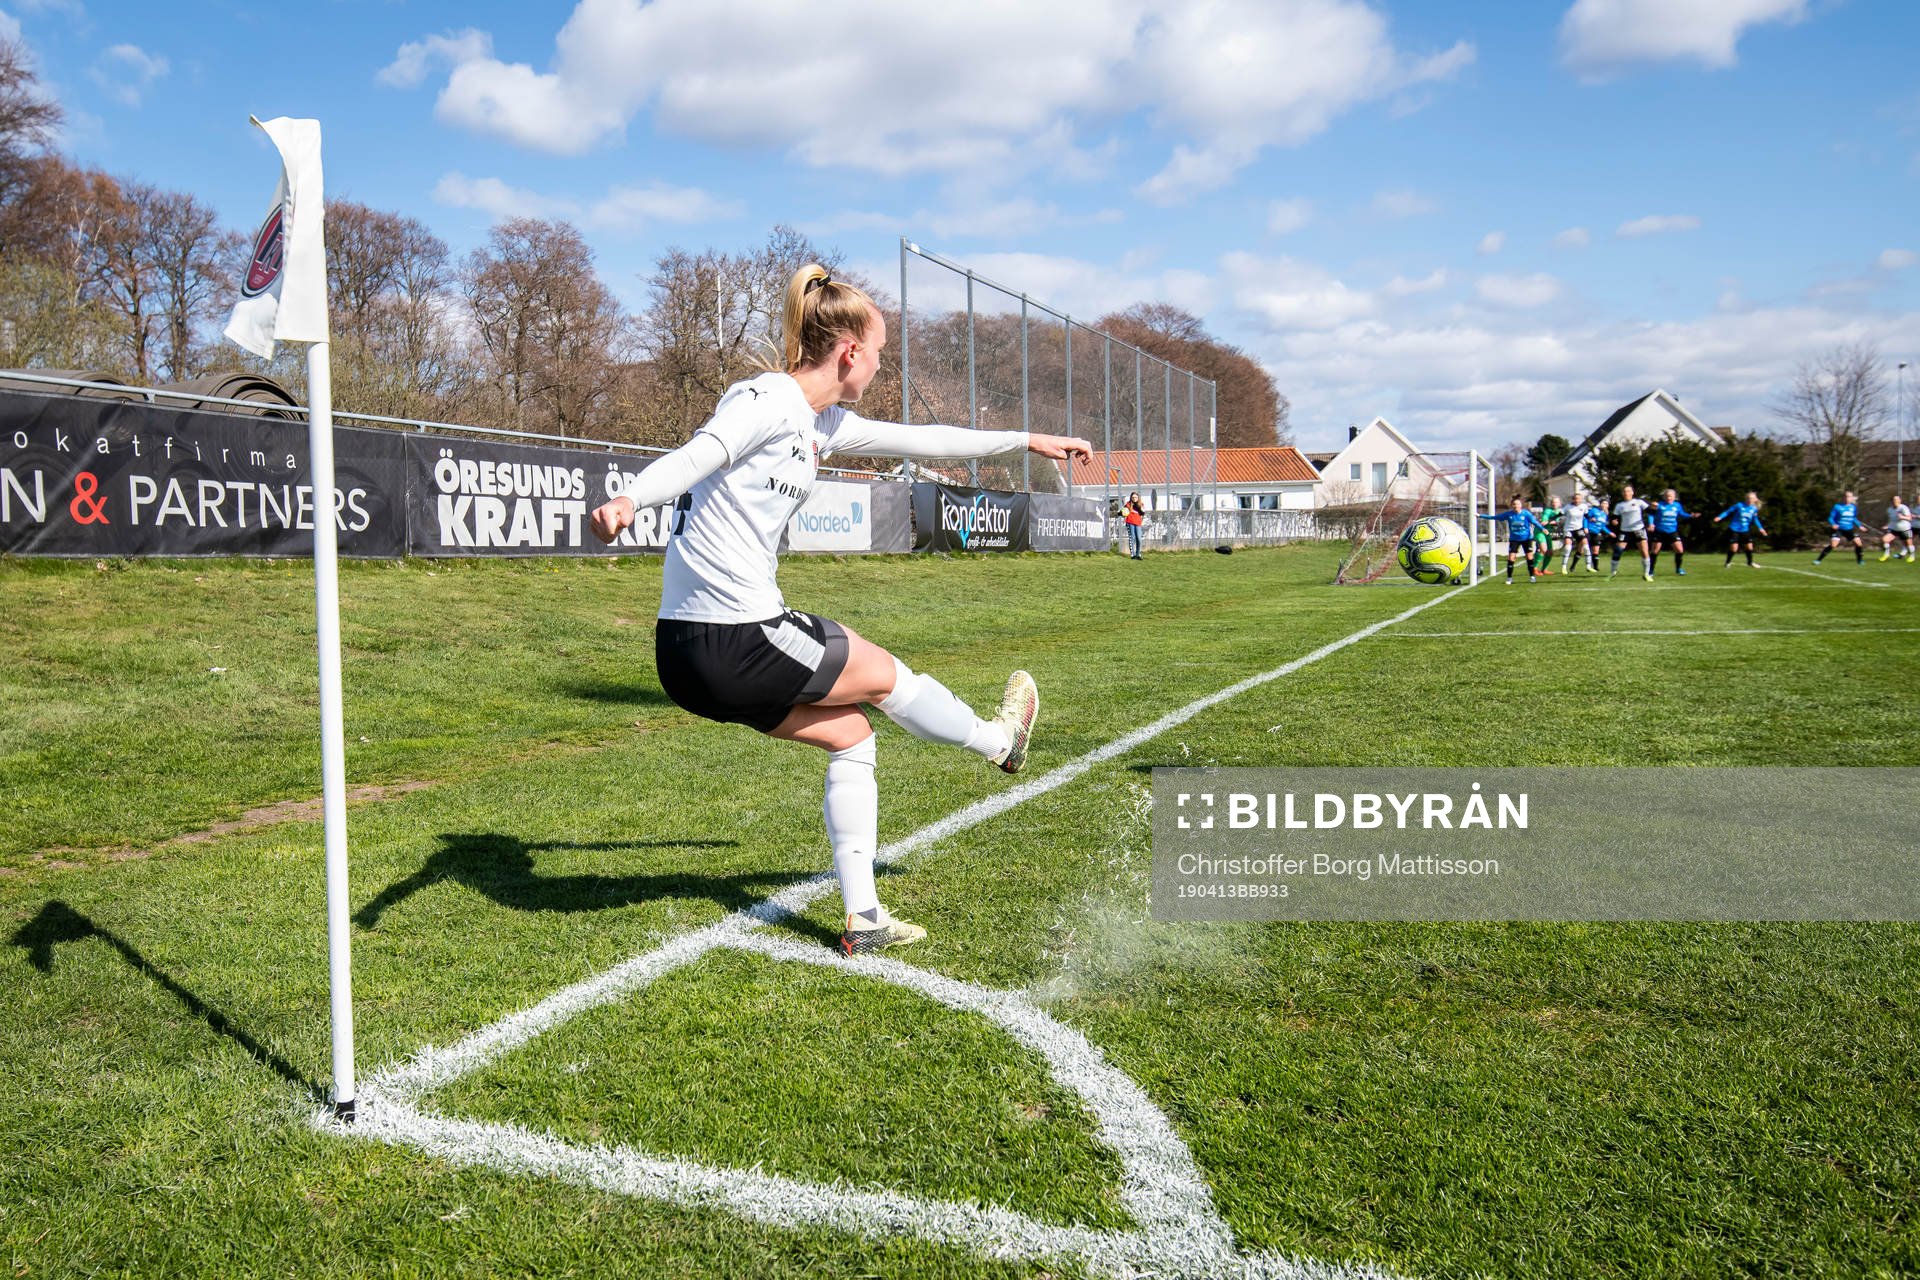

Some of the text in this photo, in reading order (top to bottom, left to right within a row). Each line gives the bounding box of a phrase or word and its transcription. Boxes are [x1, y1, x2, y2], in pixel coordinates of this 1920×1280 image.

[434, 448, 586, 499] ÖRESUNDS
[69, 471, 111, 525] &
[129, 474, 370, 532] PARTNERS
[437, 494, 586, 547] KRAFT
[797, 510, 851, 533] Nordea
[942, 493, 1011, 533] kondektor
